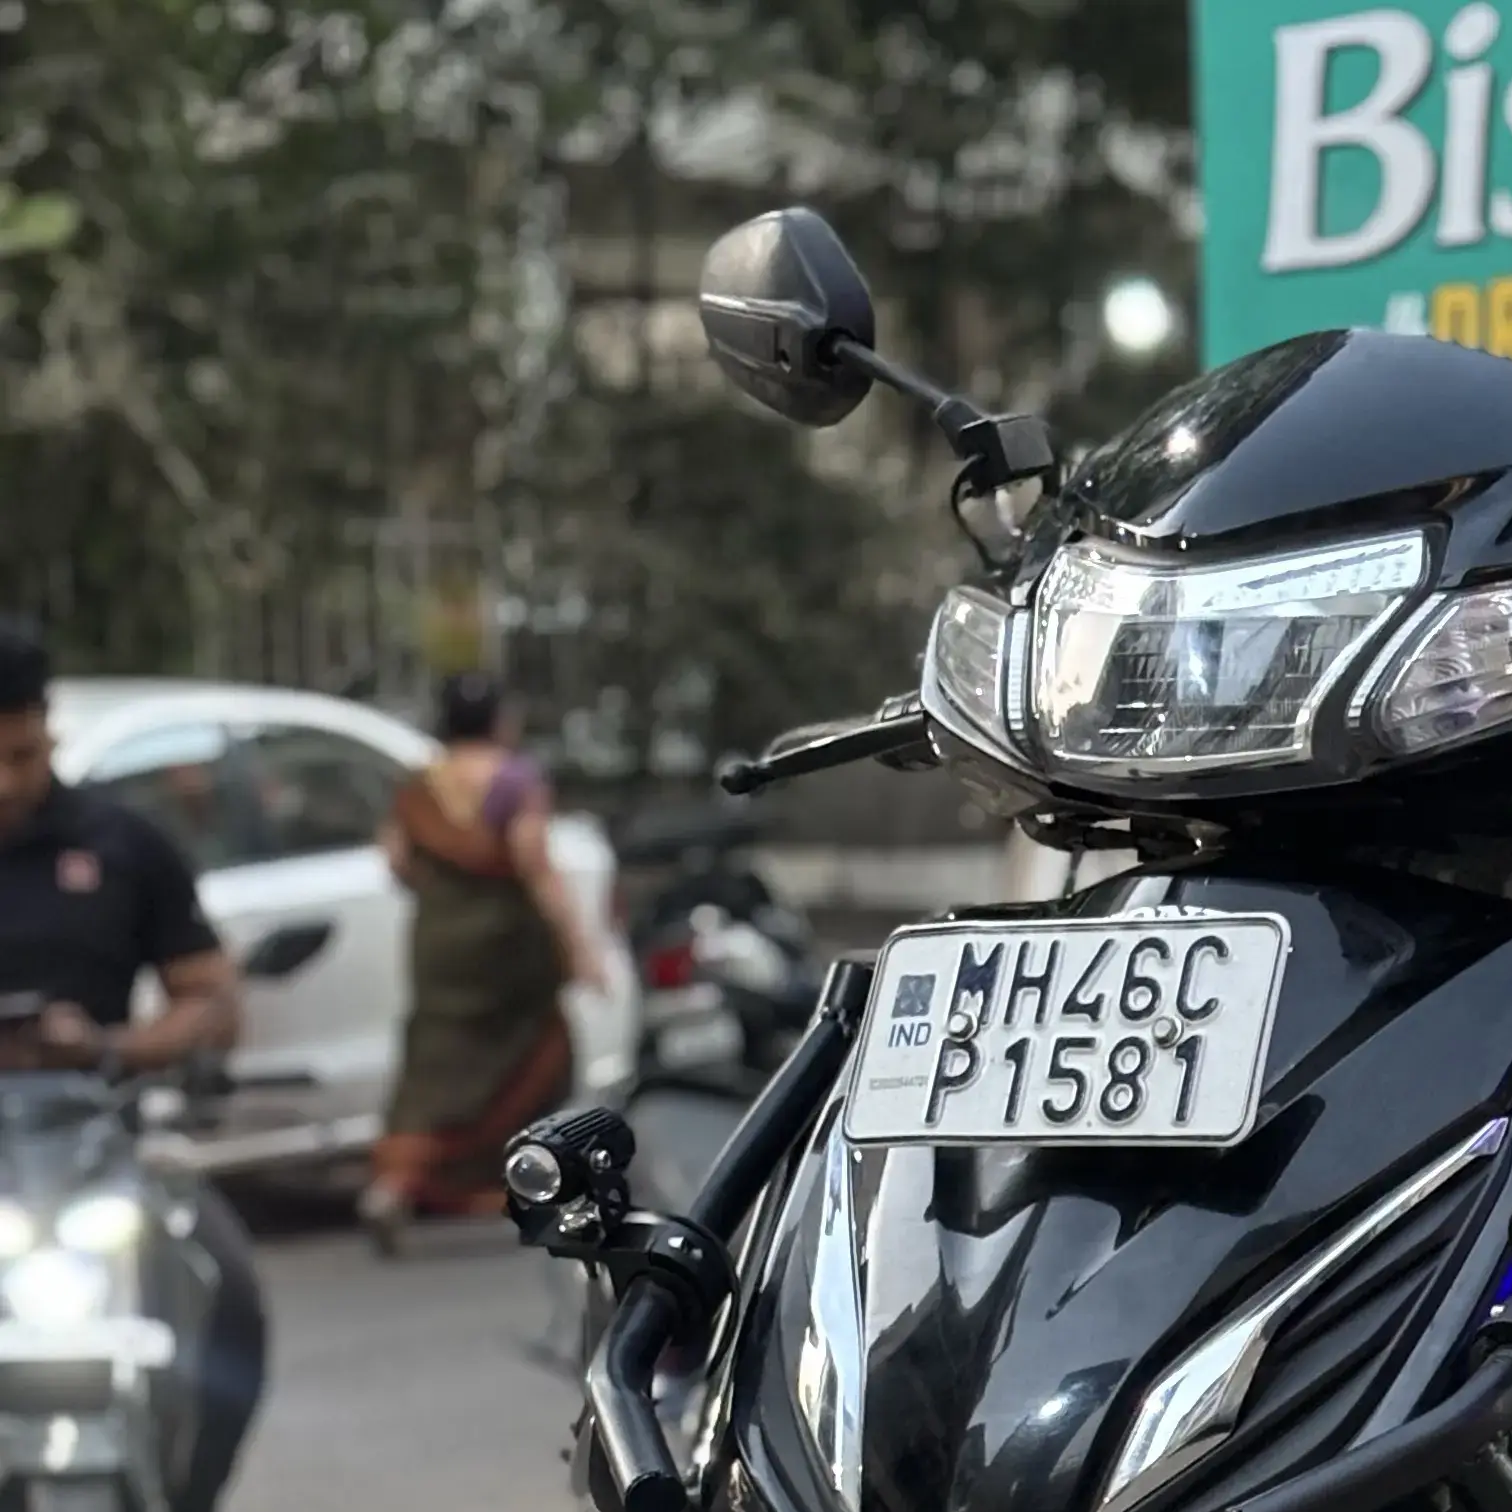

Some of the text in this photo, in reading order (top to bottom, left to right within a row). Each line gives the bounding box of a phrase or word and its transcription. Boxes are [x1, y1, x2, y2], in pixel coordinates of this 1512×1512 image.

[949, 936, 1230, 1025] MH46C
[888, 1022, 932, 1047] IND
[925, 1035, 1206, 1123] P1581
